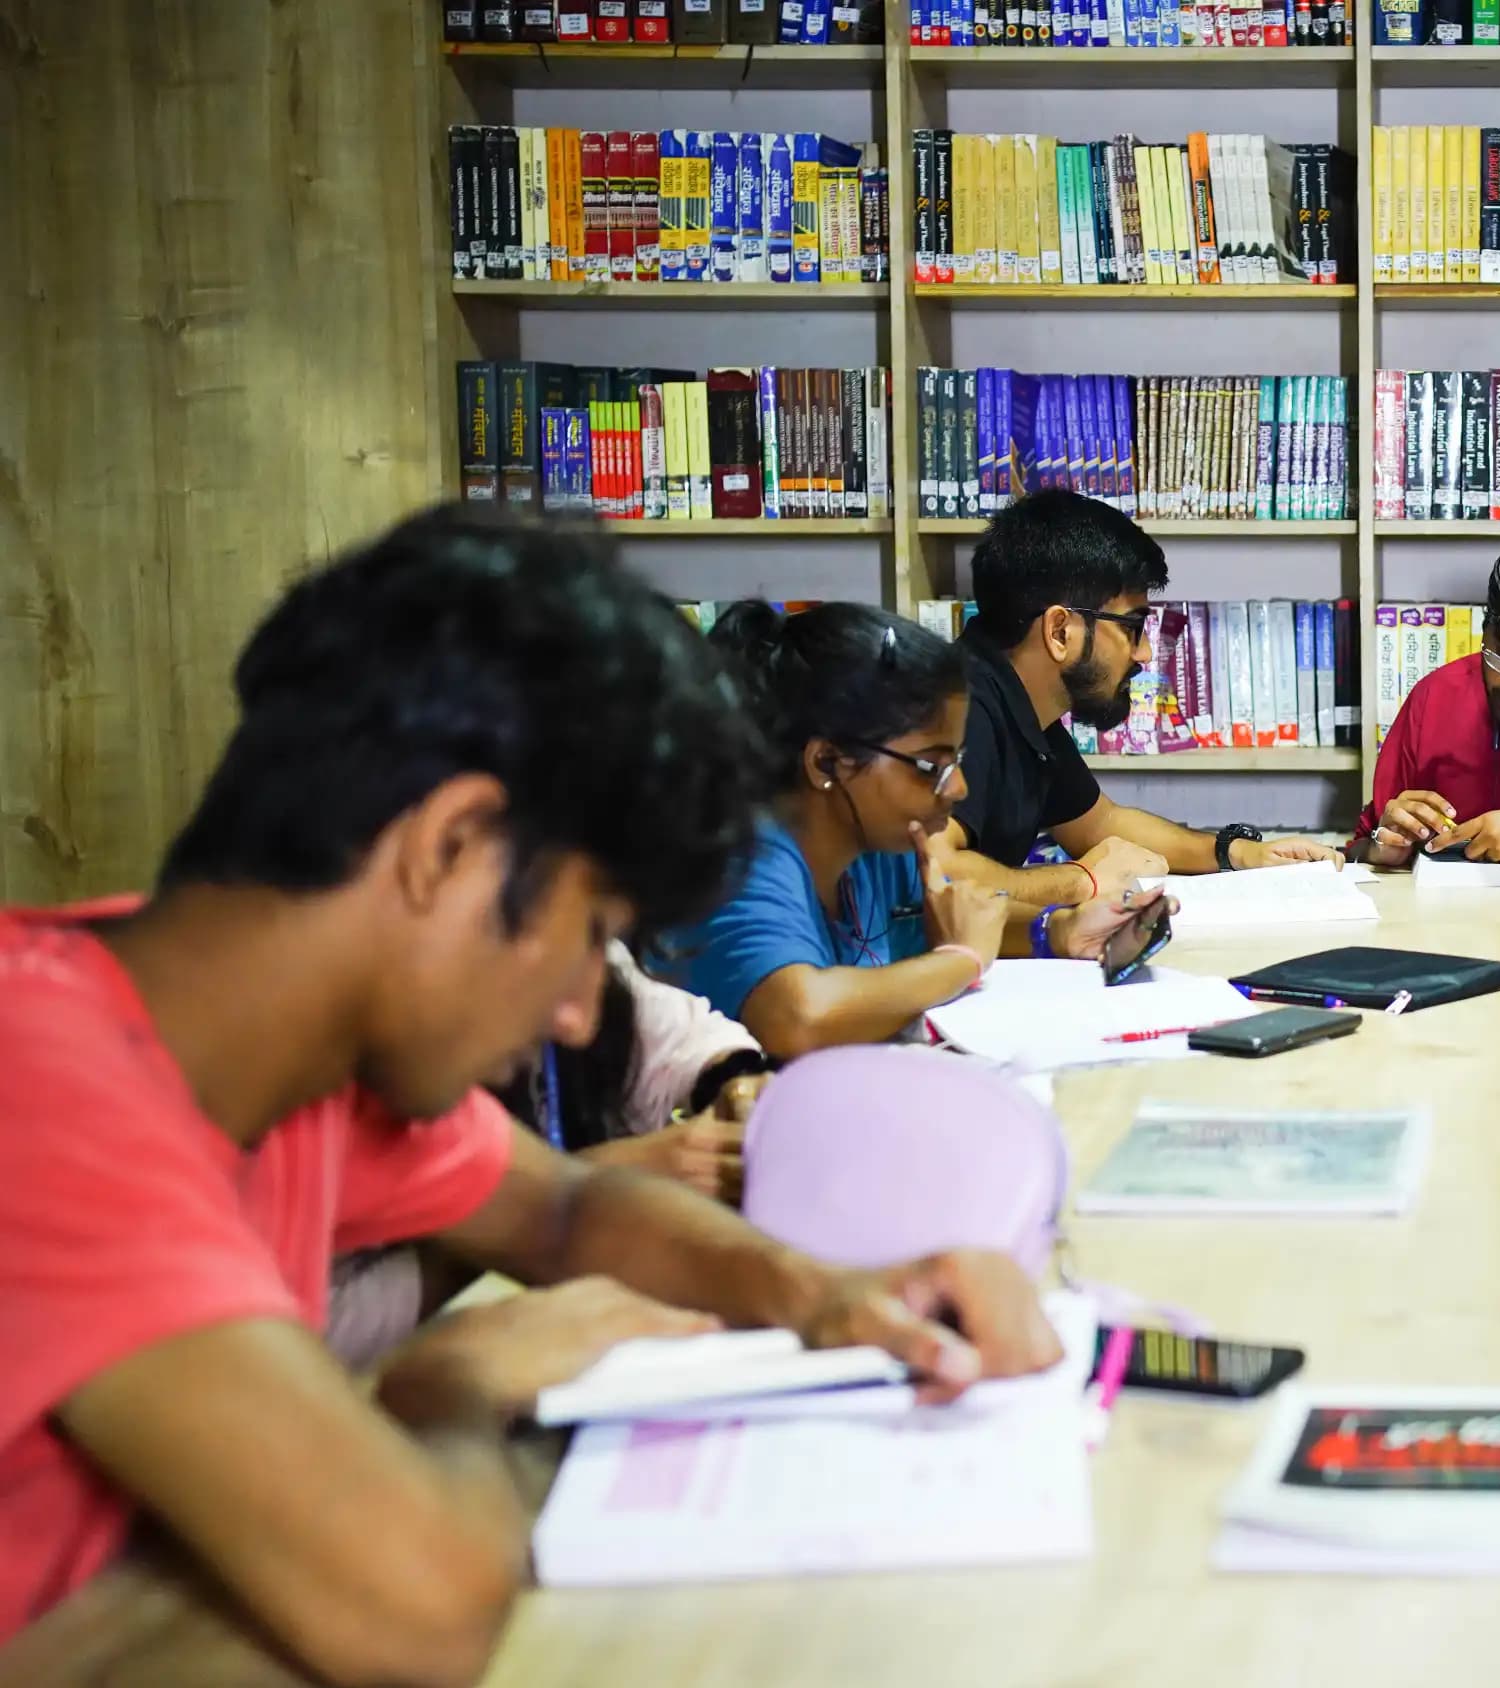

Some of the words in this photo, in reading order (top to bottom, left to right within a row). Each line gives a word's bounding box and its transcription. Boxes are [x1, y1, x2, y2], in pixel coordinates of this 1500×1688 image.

[918, 148, 928, 197] Jurisprudence
[937, 152, 947, 199] Jurisprudence
[1488, 148, 1499, 178] LABOUR
[1299, 162, 1308, 209] Jurisprudence
[1318, 162, 1327, 208] Jurisprudence
[1488, 181, 1498, 201] LAWS
[1299, 208, 1312, 223] &
[1318, 208, 1332, 223] &
[1408, 411, 1417, 452] Industrial
[1437, 409, 1446, 452] Industrial
[1466, 409, 1476, 452] Industrial
[1477, 419, 1487, 449] Labour
[1408, 455, 1417, 479] Laws
[1437, 454, 1445, 478] Laws
[1466, 454, 1475, 477] Laws
[1477, 452, 1486, 469] and
